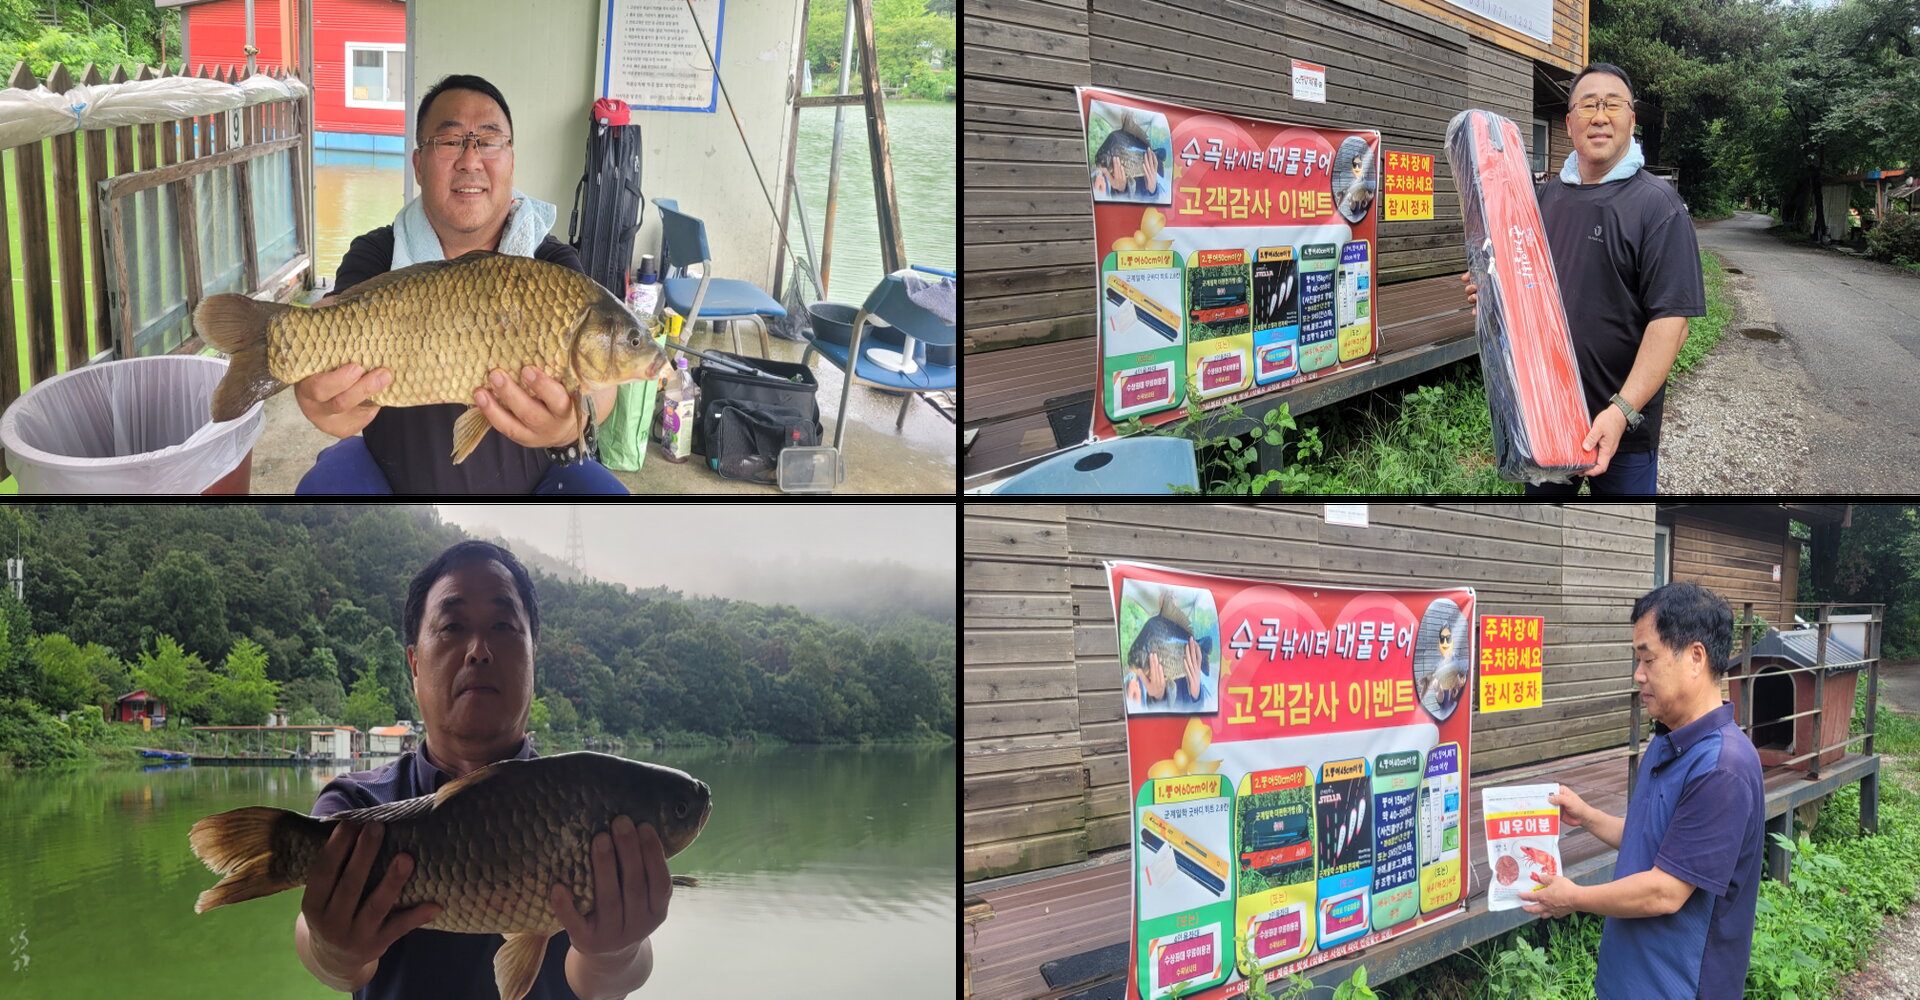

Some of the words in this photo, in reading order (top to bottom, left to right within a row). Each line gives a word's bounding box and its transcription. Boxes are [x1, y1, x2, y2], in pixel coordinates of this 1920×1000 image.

[1267, 146, 1332, 177] 대물붕어
[1388, 153, 1430, 172] 주차장에
[1385, 174, 1433, 192] 주차하세요
[1179, 186, 1272, 219] 고객감사
[1279, 189, 1334, 219] 이벤트
[1389, 199, 1430, 216] 잠시정차
[1335, 621, 1415, 661] 대물붕어
[1485, 618, 1539, 642] 주차장에
[1480, 647, 1542, 672] 주차하세요
[1227, 681, 1339, 727] 고객감사
[1349, 678, 1415, 720] 이벤트
[1485, 680, 1537, 706] 잠시정차
[1158, 780, 1217, 798] 1.붕어60cm이상
[1255, 771, 1303, 789] 2.붕어50cm이상
[1499, 817, 1550, 835] 새우어분
